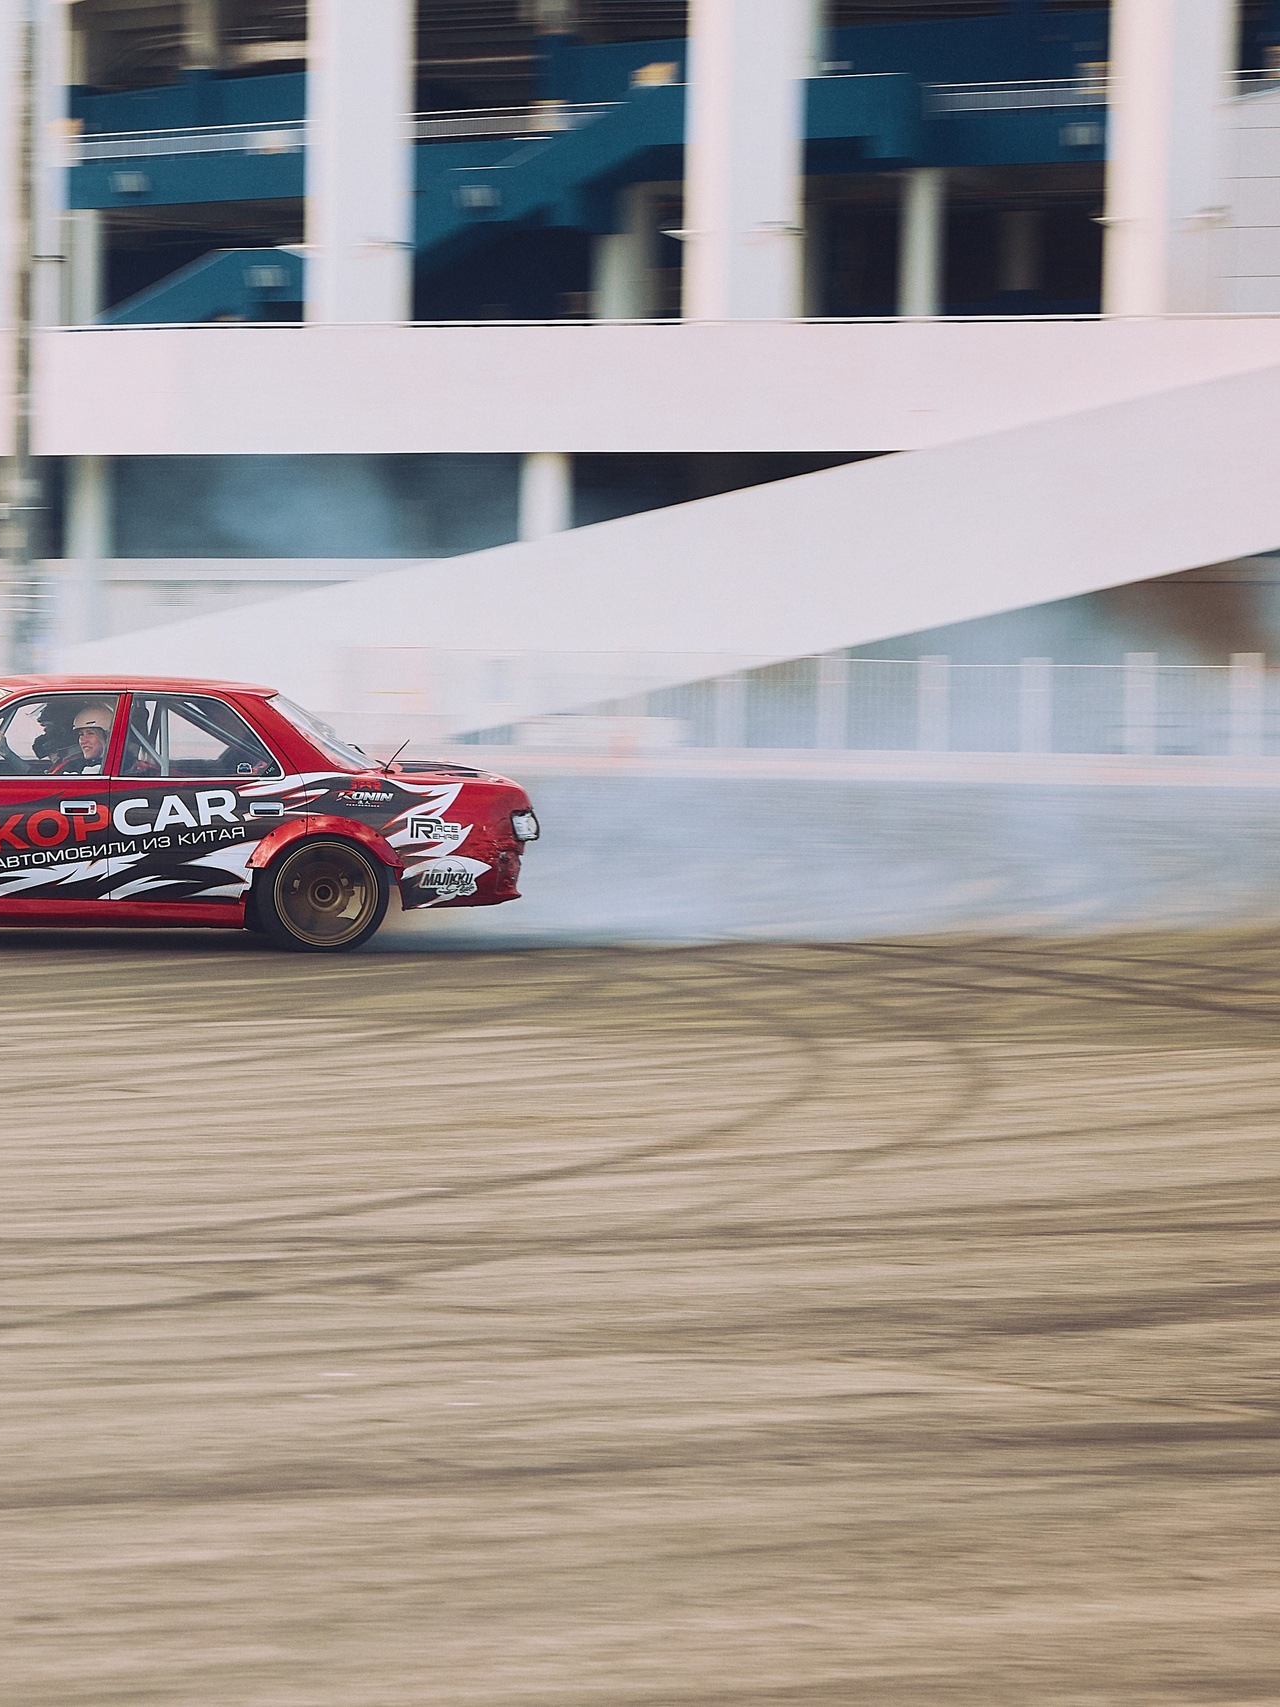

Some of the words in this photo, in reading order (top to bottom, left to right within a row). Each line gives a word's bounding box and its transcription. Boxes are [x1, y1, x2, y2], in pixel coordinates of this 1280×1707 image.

[332, 789, 394, 801] RONIN
[142, 834, 172, 849] ИЗ
[178, 826, 246, 846] КИТАЯ
[422, 873, 473, 886] MAJIKKU
